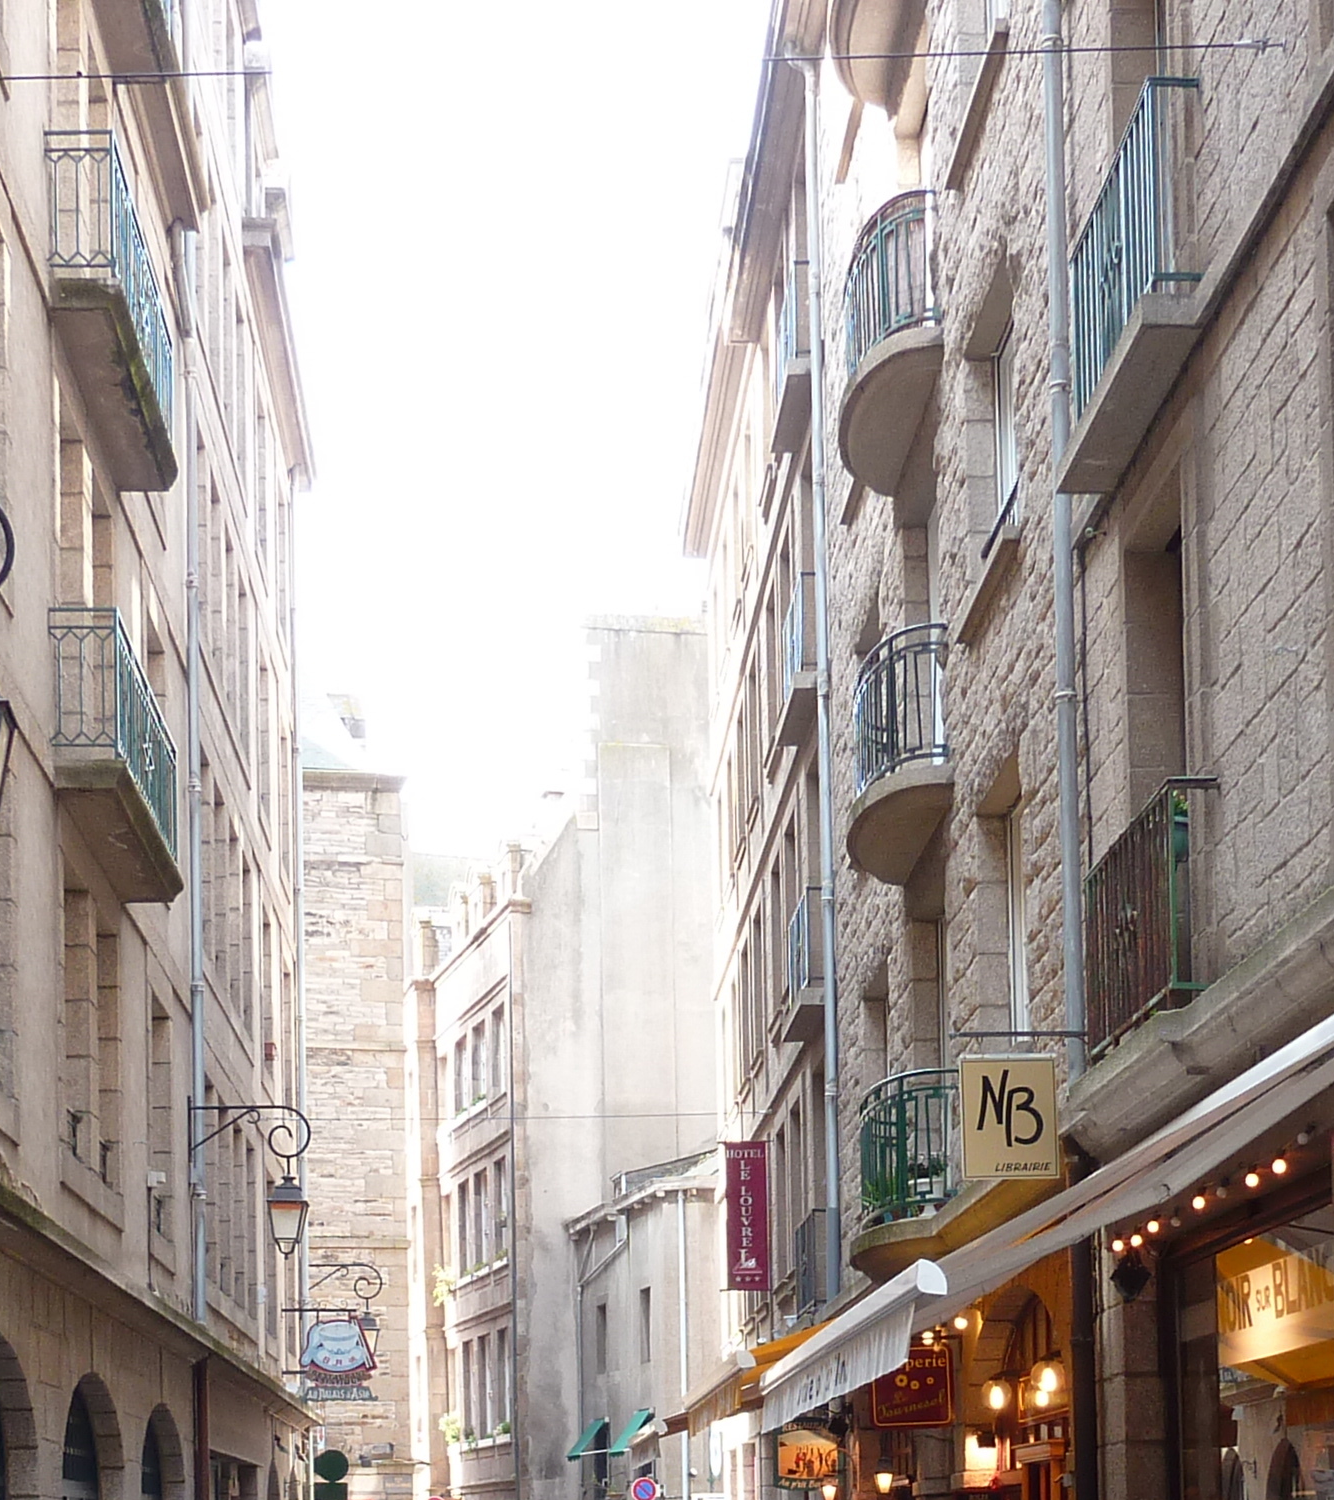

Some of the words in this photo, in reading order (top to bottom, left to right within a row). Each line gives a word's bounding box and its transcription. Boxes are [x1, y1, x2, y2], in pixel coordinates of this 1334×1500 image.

[976, 1069, 1044, 1147] NB
[726, 1149, 764, 1158] HOTEL
[740, 1160, 751, 1180] LE
[995, 1162, 1052, 1172] LIBRAIRIE
[740, 1186, 754, 1247] LOUVRE
